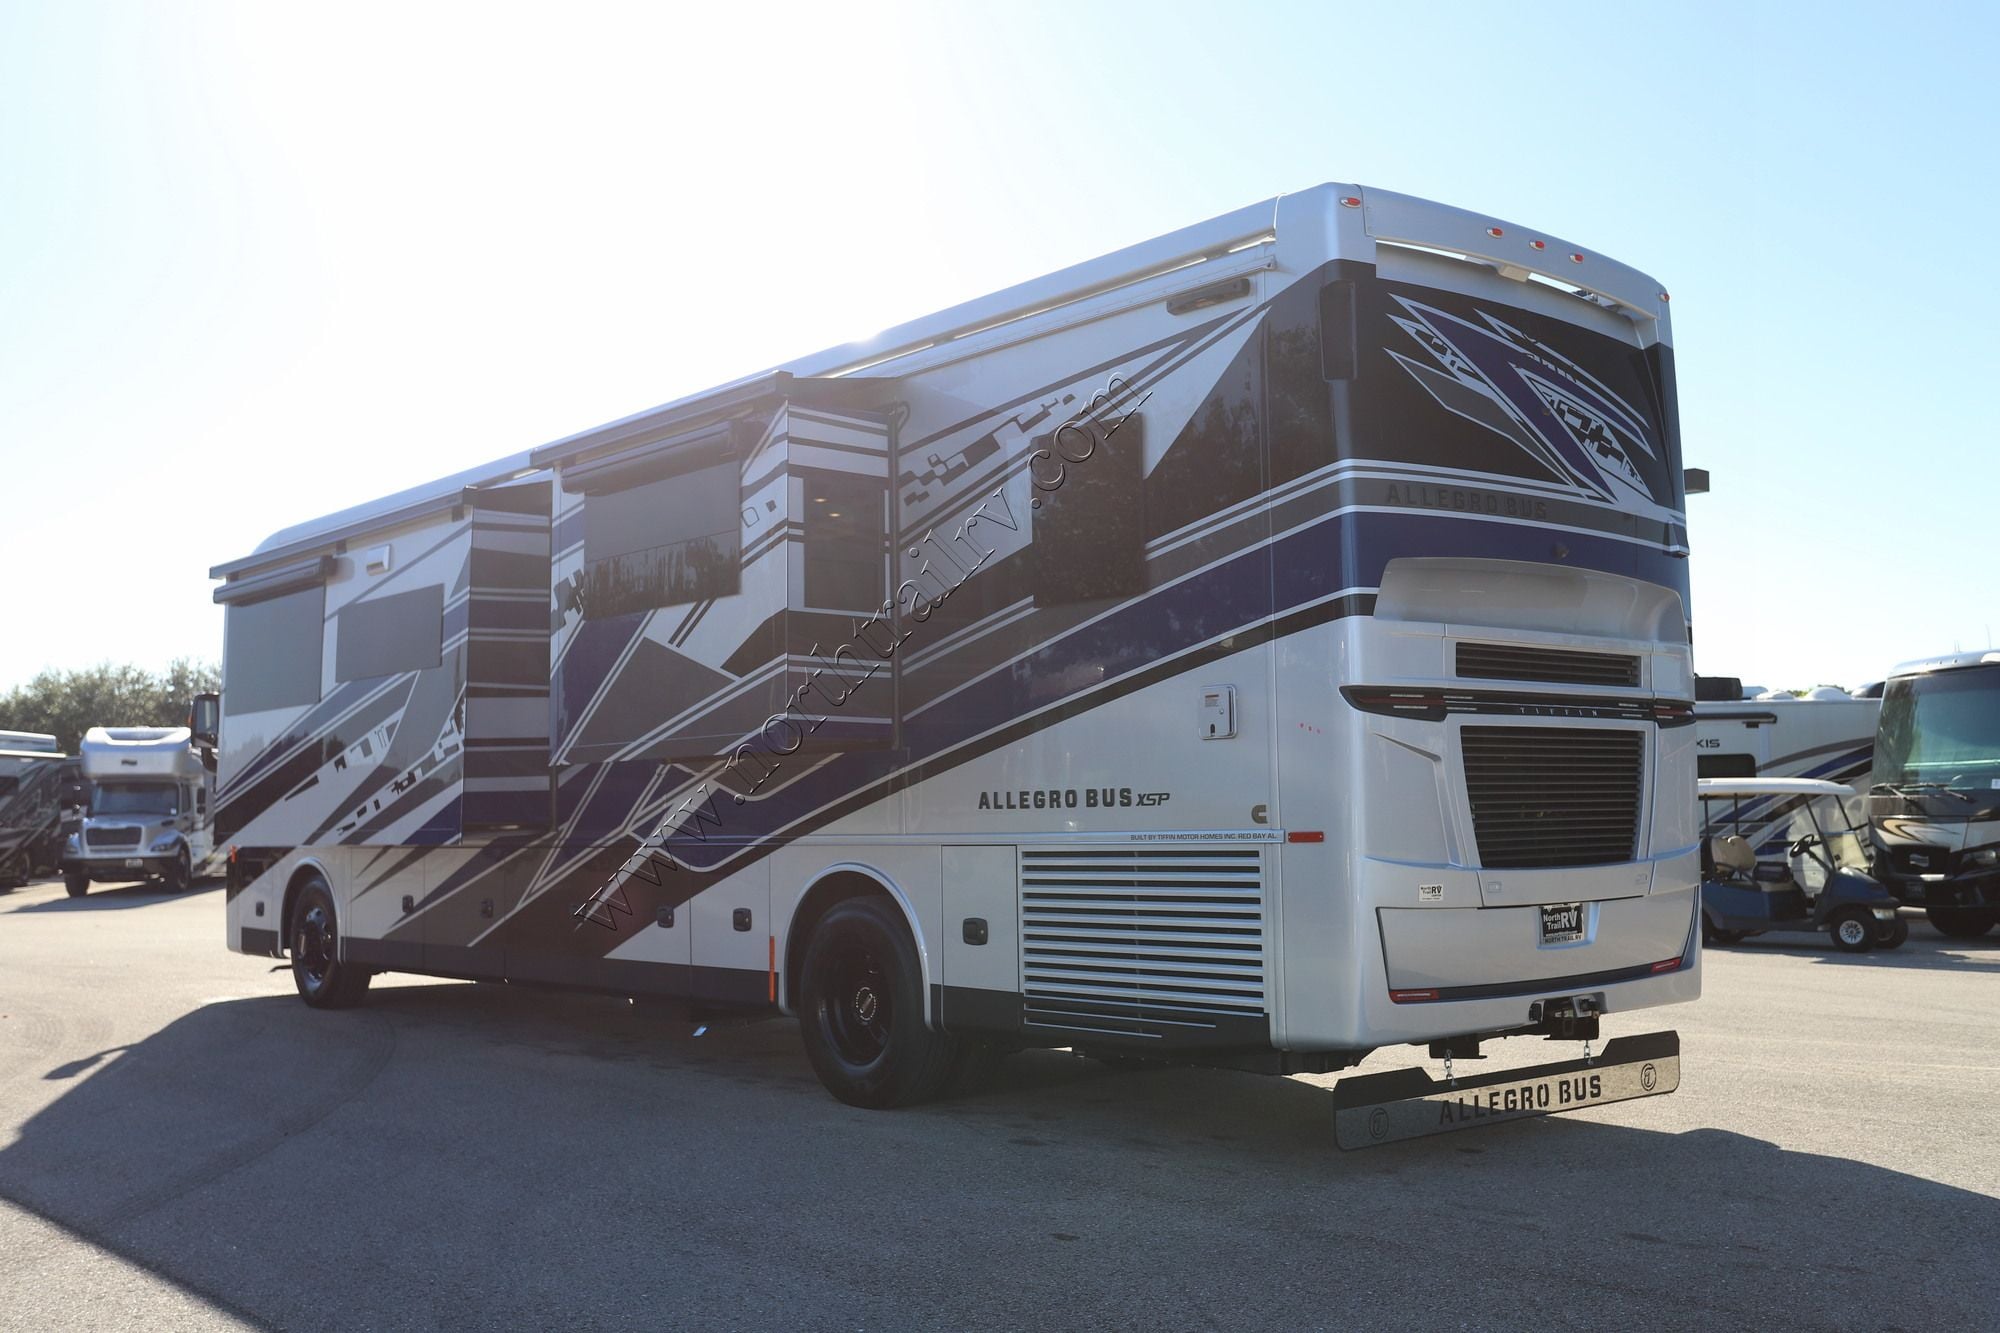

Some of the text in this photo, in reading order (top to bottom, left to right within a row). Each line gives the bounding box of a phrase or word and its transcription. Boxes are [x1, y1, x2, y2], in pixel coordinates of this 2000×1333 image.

[1387, 483, 1548, 519] ALLEGRO BUS
[1696, 739, 1720, 748] XIS
[978, 787, 1170, 810] ALLEGRO BUS XSP
[1432, 885, 1442, 894] RV
[1543, 912, 1561, 922] North
[1561, 910, 1578, 929] RV
[1547, 921, 1561, 930] Trail
[1439, 1074, 1602, 1126] ALLEGRO BUS
